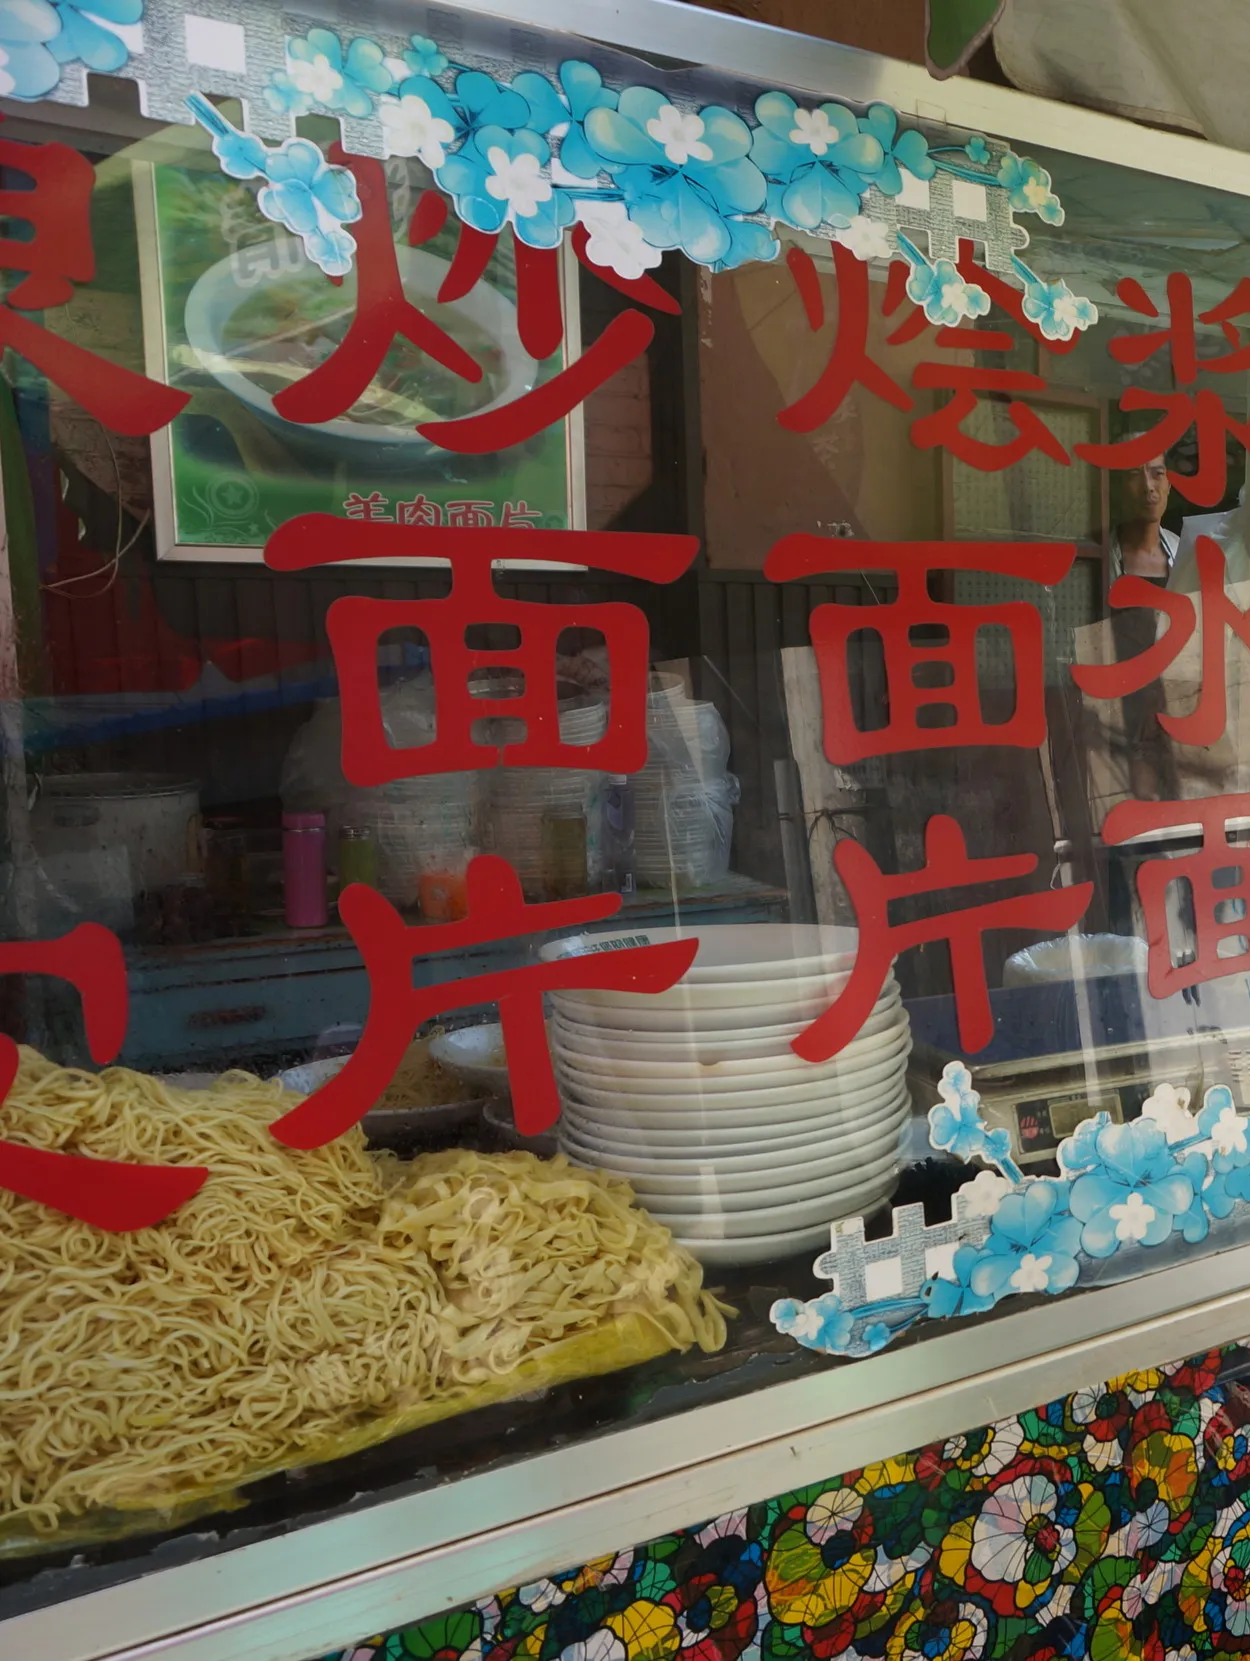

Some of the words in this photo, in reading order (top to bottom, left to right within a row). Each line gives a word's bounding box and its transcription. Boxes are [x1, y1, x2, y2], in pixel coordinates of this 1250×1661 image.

[263, 140, 700, 1150] 炒面片
[343, 491, 543, 530] 羊肉面片
[763, 240, 1093, 1063] 烩面片
